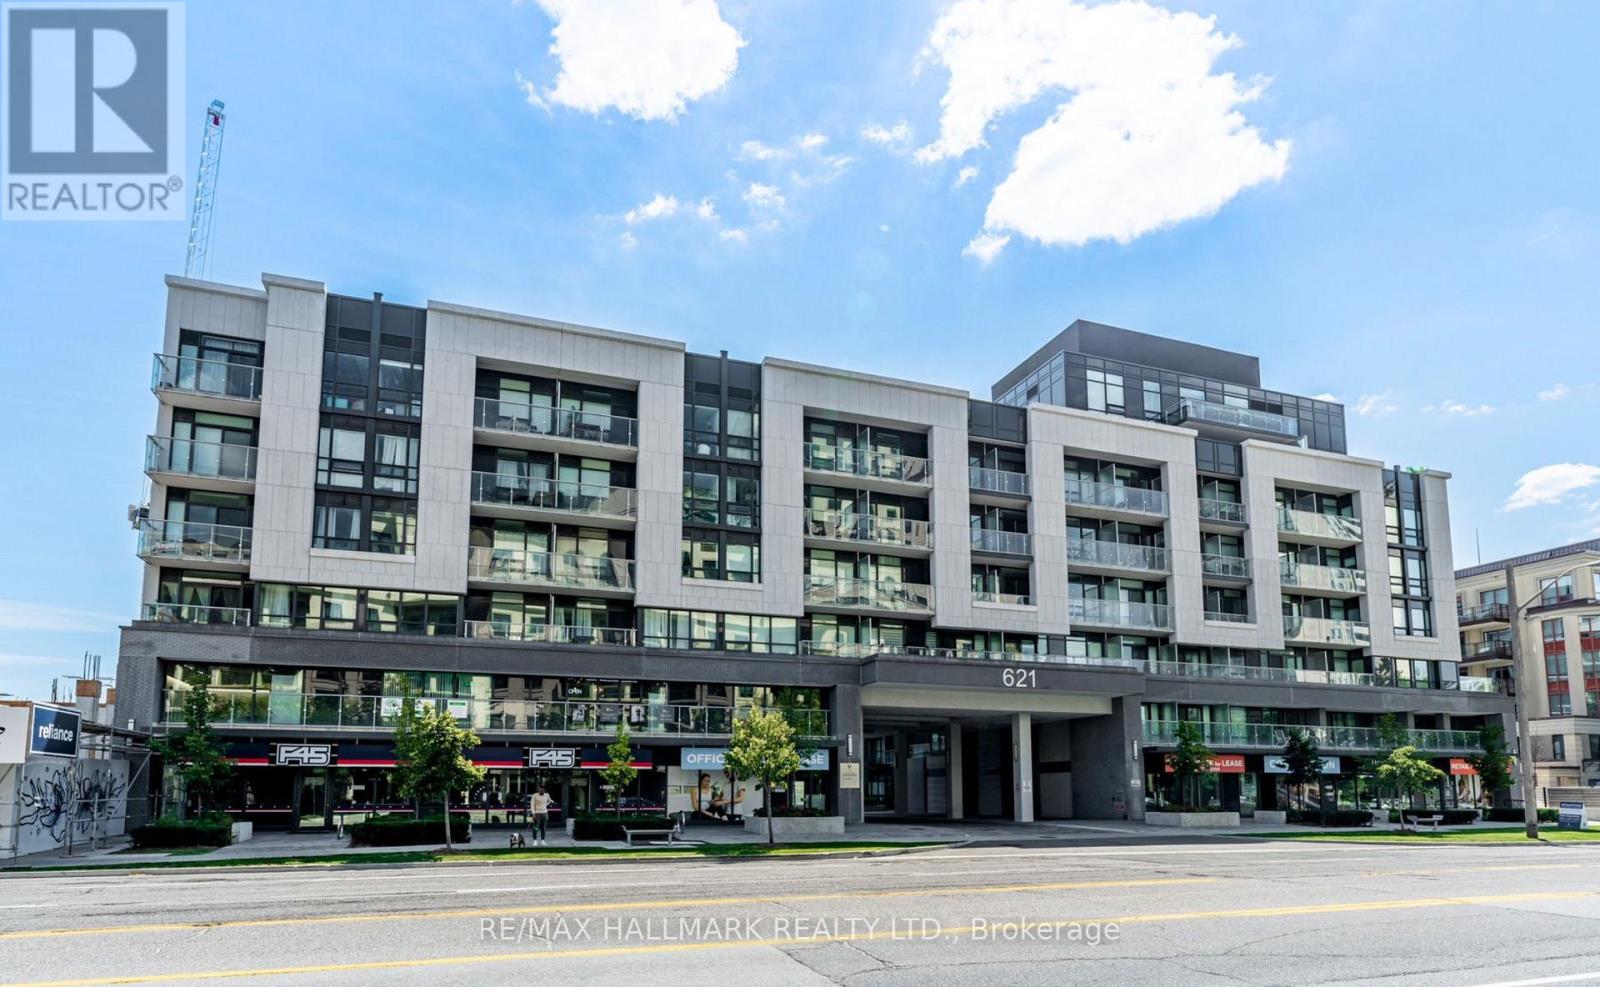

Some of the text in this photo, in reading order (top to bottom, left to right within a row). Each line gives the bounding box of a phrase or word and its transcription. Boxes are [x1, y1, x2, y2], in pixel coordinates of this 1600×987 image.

[1003, 668, 1035, 688] 621
[39, 723, 73, 741] reliance
[278, 745, 330, 765] F45
[530, 748, 575, 767] F45
[687, 753, 725, 764] OFFIC
[1221, 759, 1243, 767] LEASE
